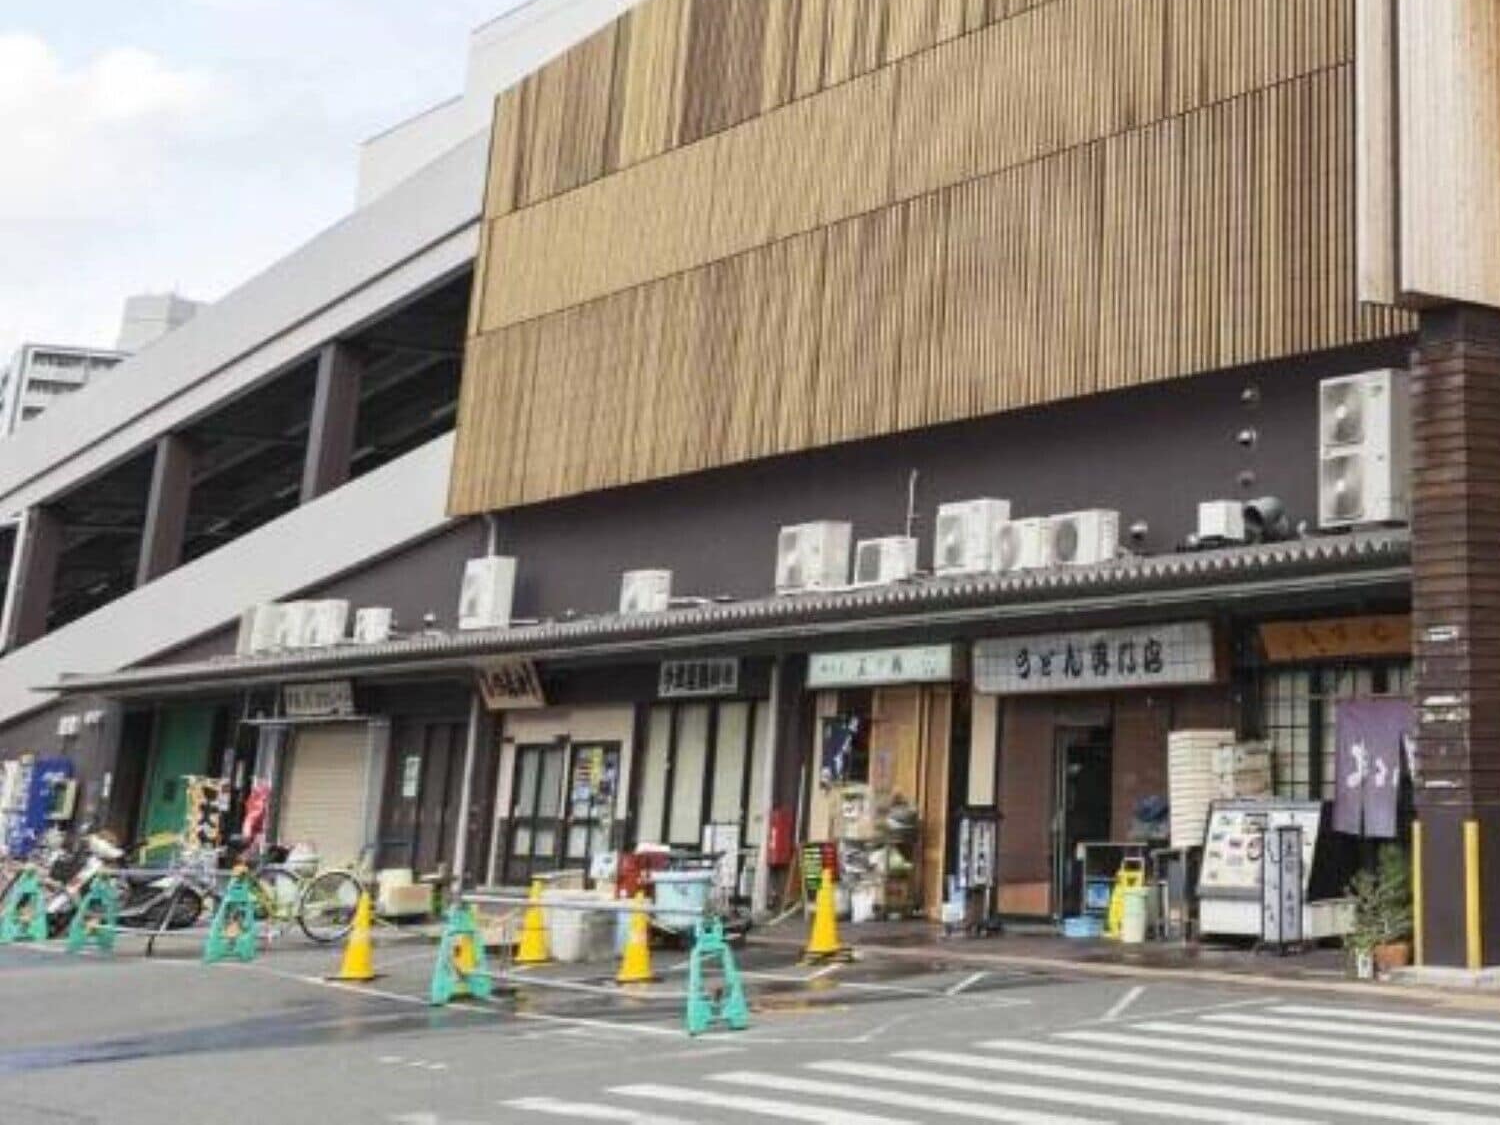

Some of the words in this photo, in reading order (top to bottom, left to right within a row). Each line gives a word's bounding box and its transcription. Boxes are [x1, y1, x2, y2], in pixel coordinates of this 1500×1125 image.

[1014, 637, 1165, 680] うどん専門店
